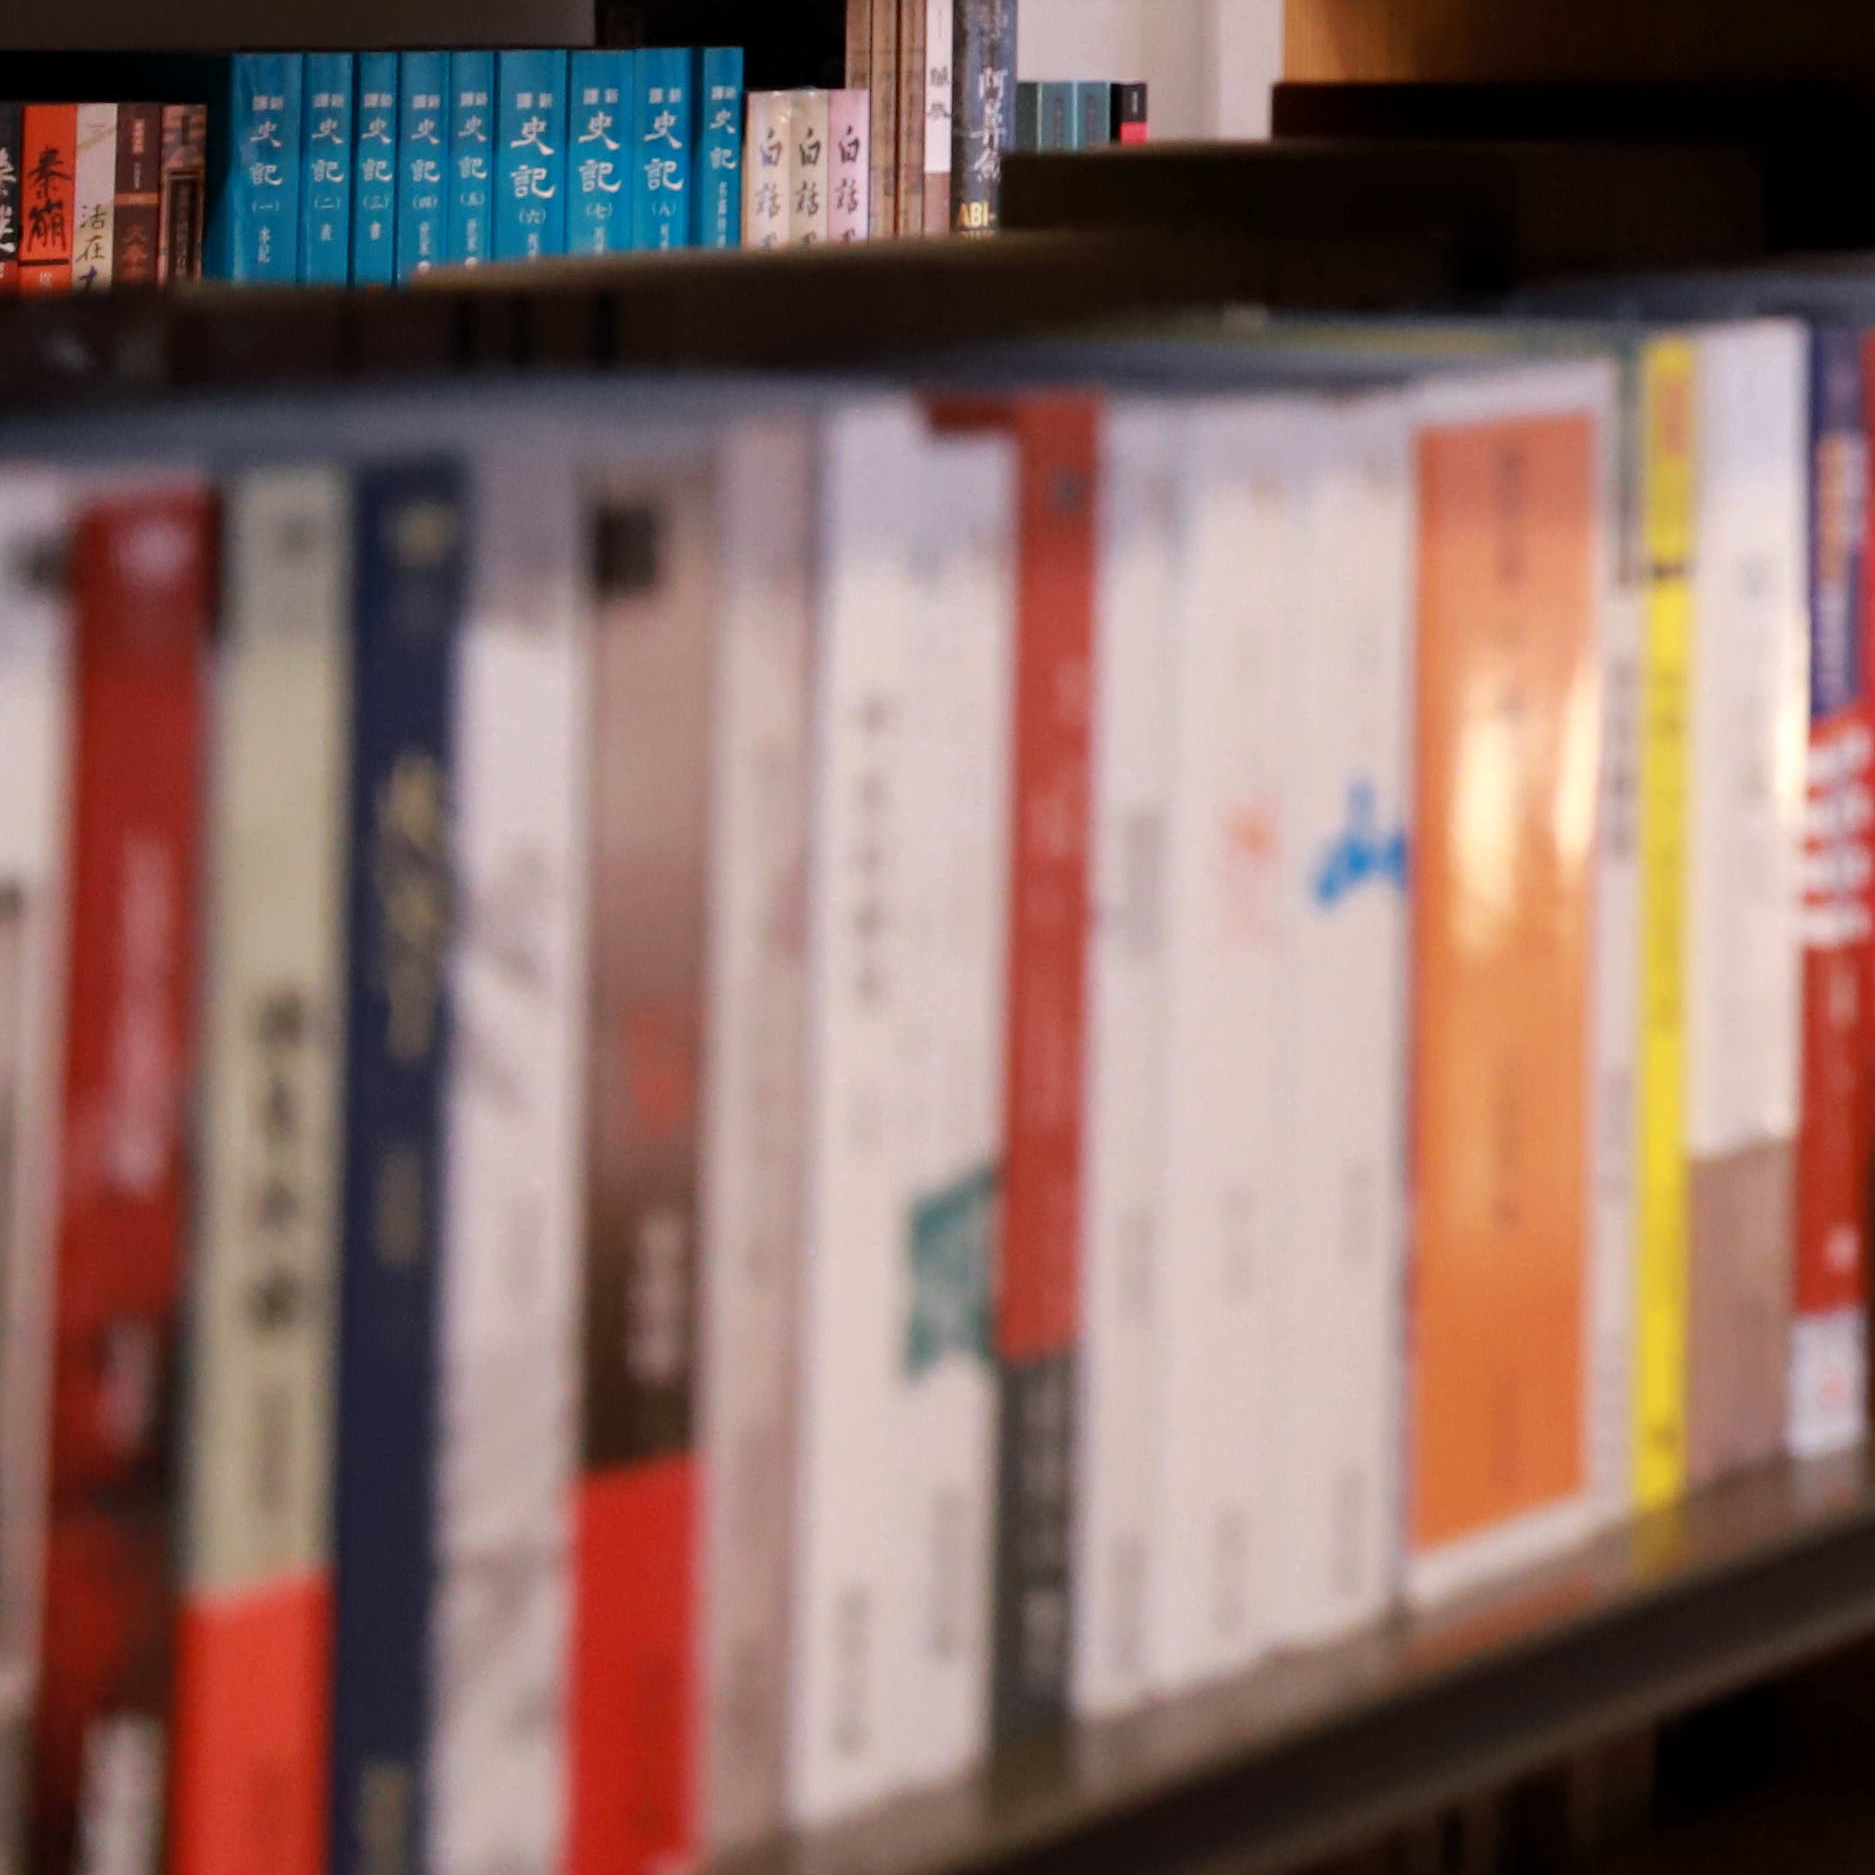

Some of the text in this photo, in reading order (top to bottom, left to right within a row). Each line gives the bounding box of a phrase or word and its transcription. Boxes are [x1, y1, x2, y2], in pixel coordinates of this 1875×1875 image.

[250, 120, 283, 186] 史記
[312, 117, 344, 182] 史記
[361, 117, 393, 182] 史記
[411, 118, 440, 182] 史記
[458, 115, 488, 180] 史記
[510, 116, 556, 199] 史記
[578, 110, 622, 193] 史記
[644, 110, 684, 191] 史記
[709, 109, 736, 170] 史記
